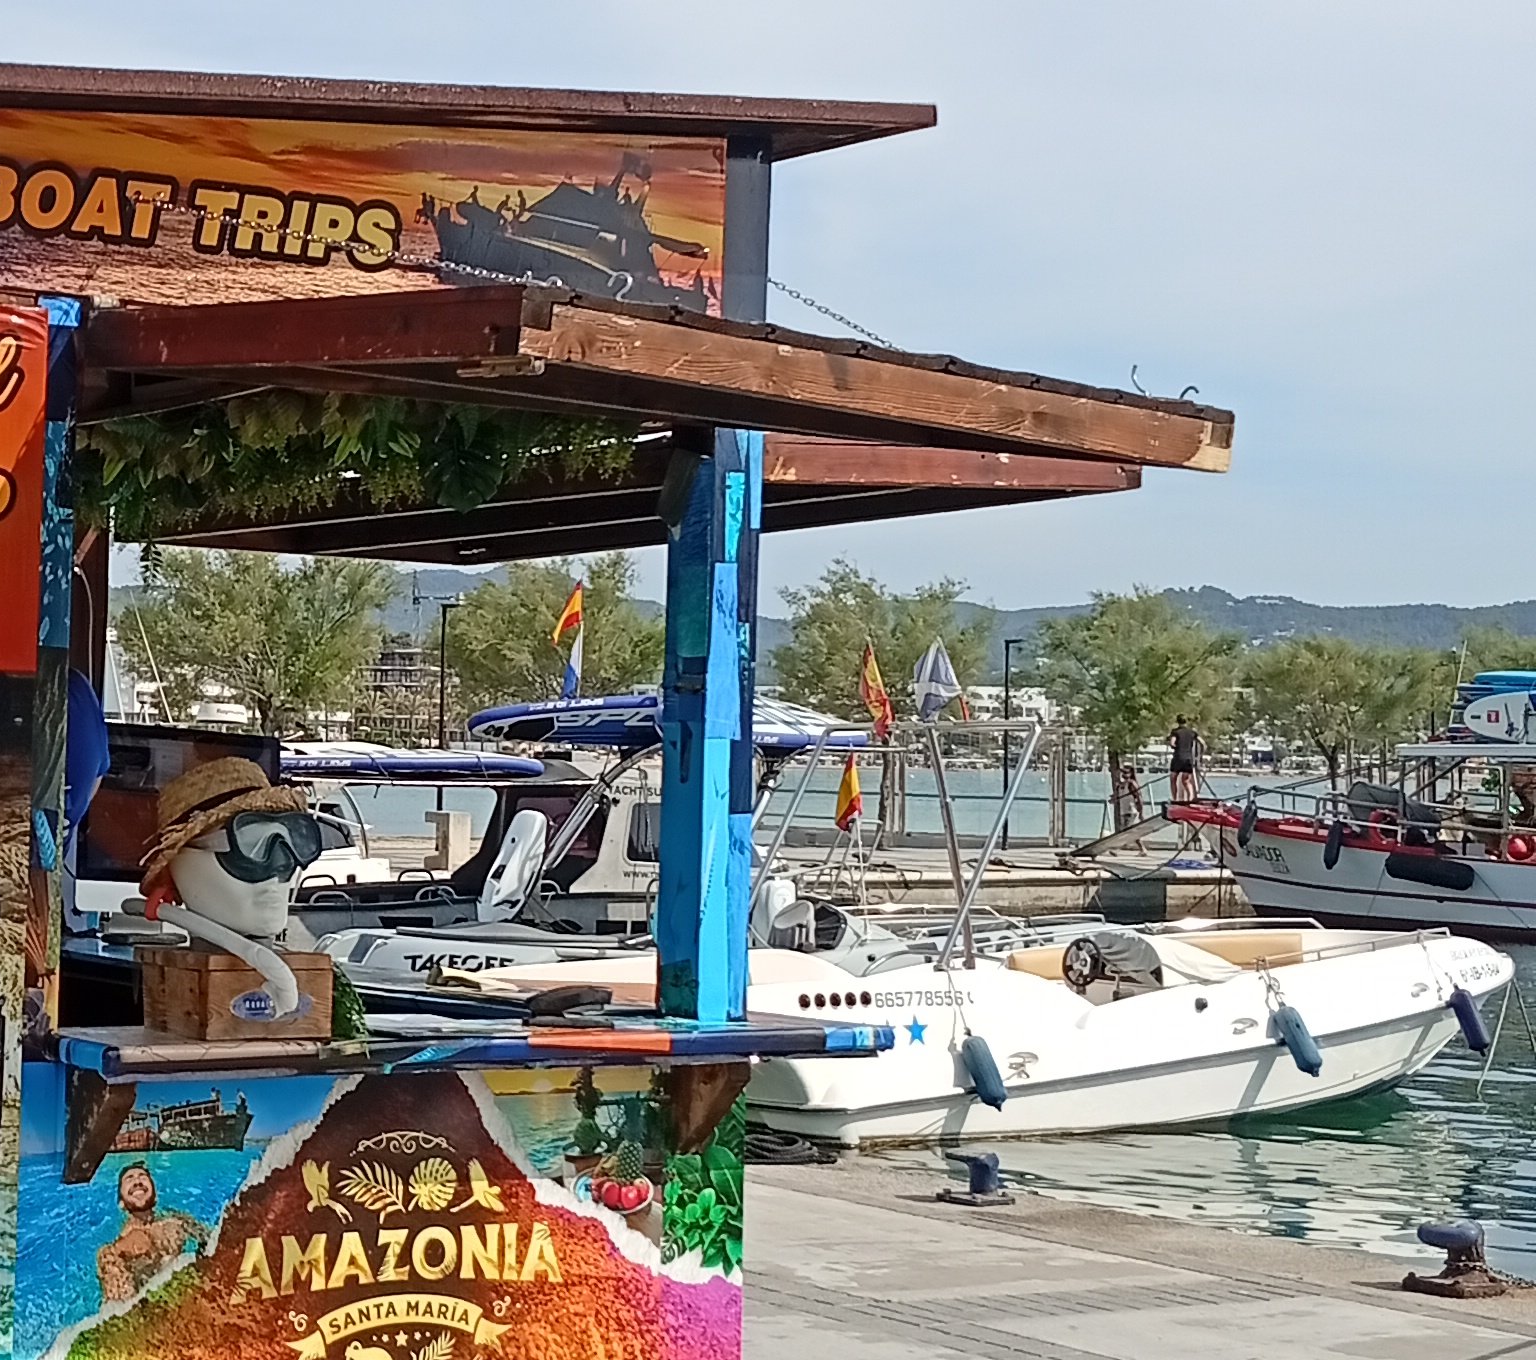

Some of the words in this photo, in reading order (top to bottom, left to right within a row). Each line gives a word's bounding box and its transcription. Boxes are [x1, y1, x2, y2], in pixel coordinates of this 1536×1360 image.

[195, 189, 397, 265] TRIPS
[874, 990, 964, 1008] 665778556
[229, 1222, 564, 1305] AMAZONIA
[328, 1300, 400, 1336] SANTA
[405, 1300, 471, 1327] MARÍA
